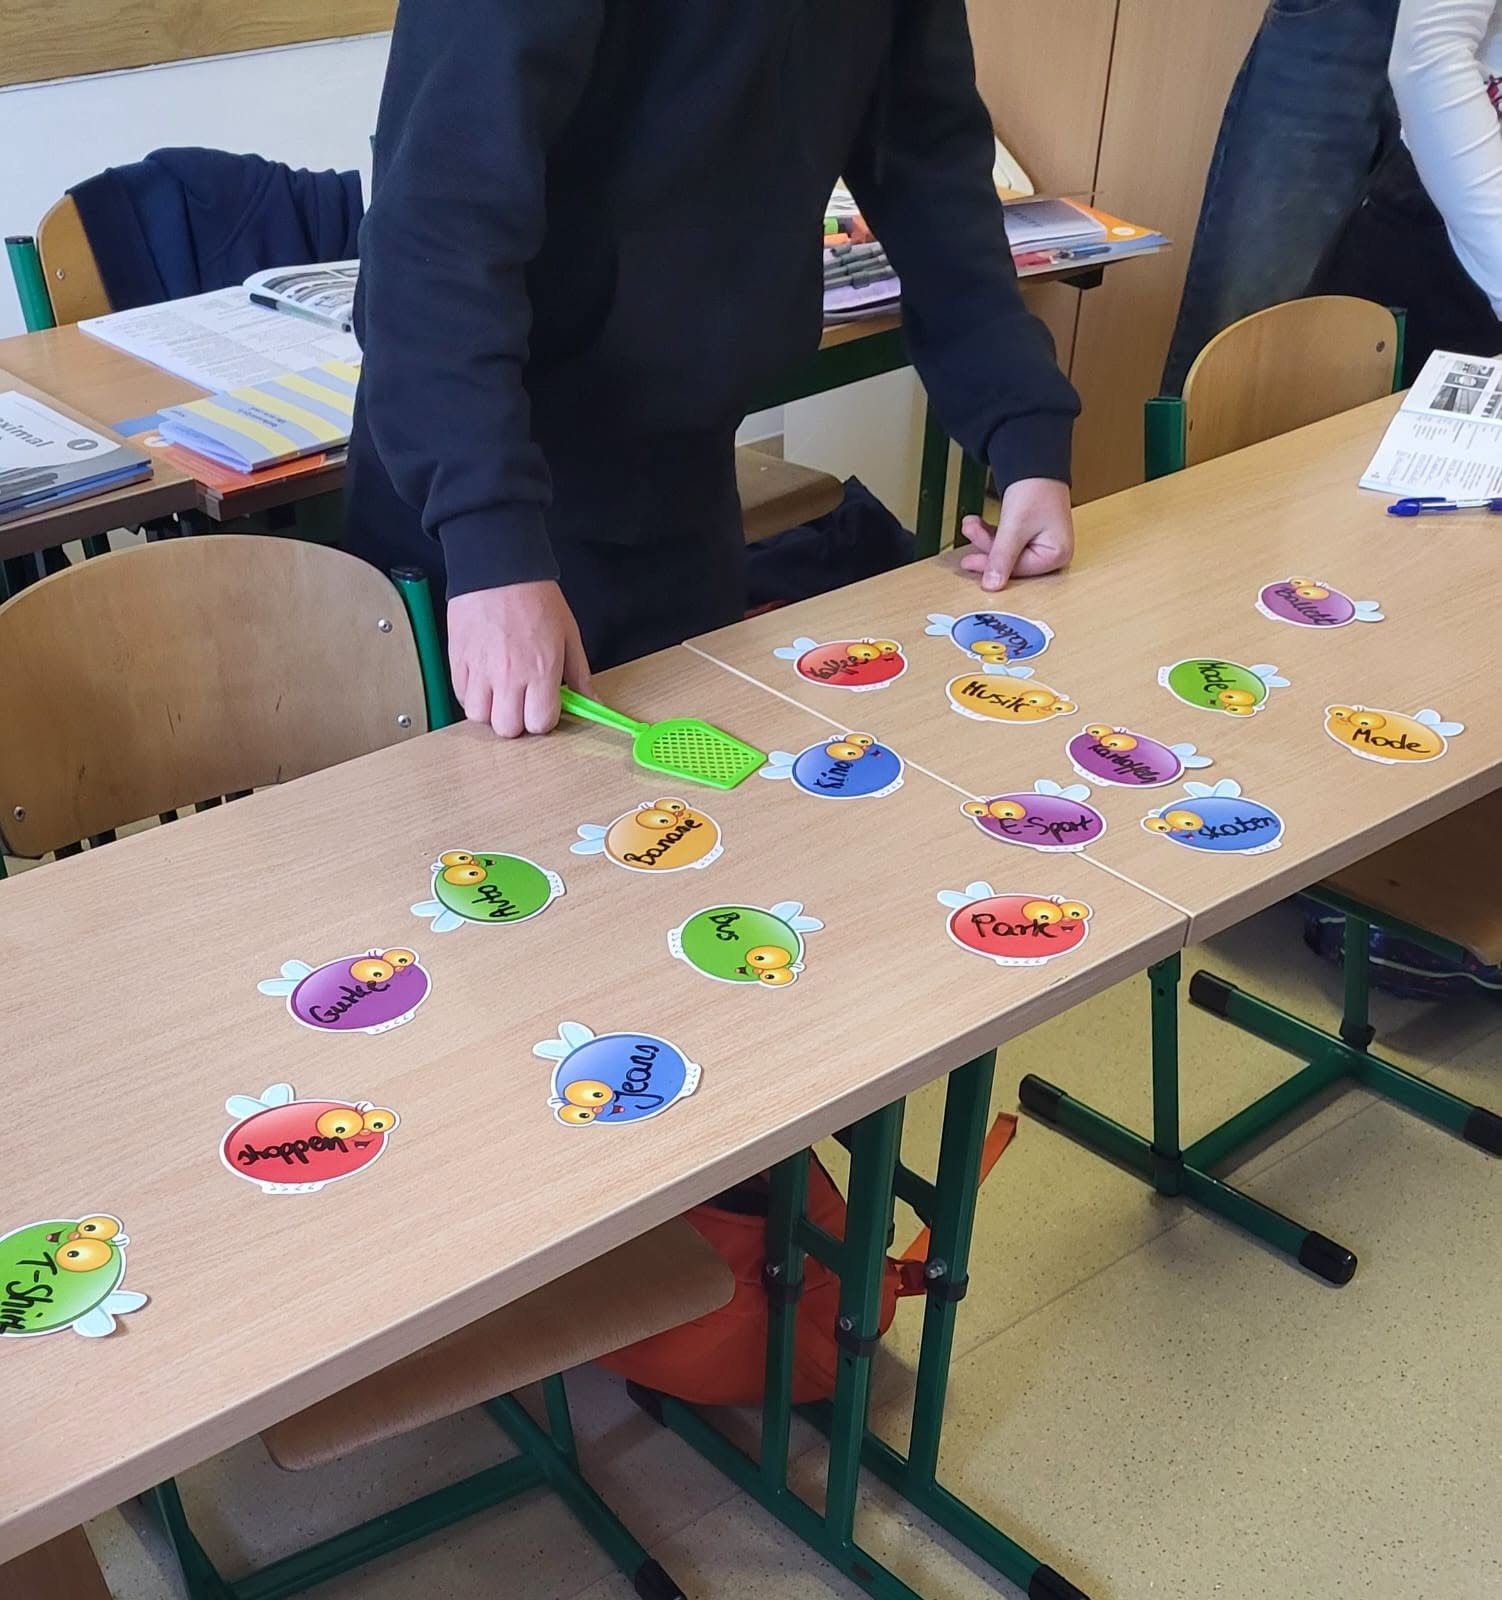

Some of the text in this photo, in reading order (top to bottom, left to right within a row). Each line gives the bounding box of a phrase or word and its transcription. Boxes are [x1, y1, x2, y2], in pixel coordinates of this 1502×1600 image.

[1275, 586, 1338, 625] Ballett
[806, 655, 868, 680] Kaffee
[961, 680, 1030, 713] Musik
[1352, 728, 1431, 754] Mode
[813, 760, 854, 791] Kino
[1088, 744, 1160, 784] Kartoffeln
[623, 819, 703, 866] Banane
[999, 815, 1094, 842] E-Sport
[472, 884, 520, 918] Auto
[709, 912, 740, 942] Bus
[971, 913, 1058, 938] Park
[309, 980, 391, 1024] Gurke
[612, 1043, 664, 1110] Jeans
[237, 1135, 349, 1166] shoppen
